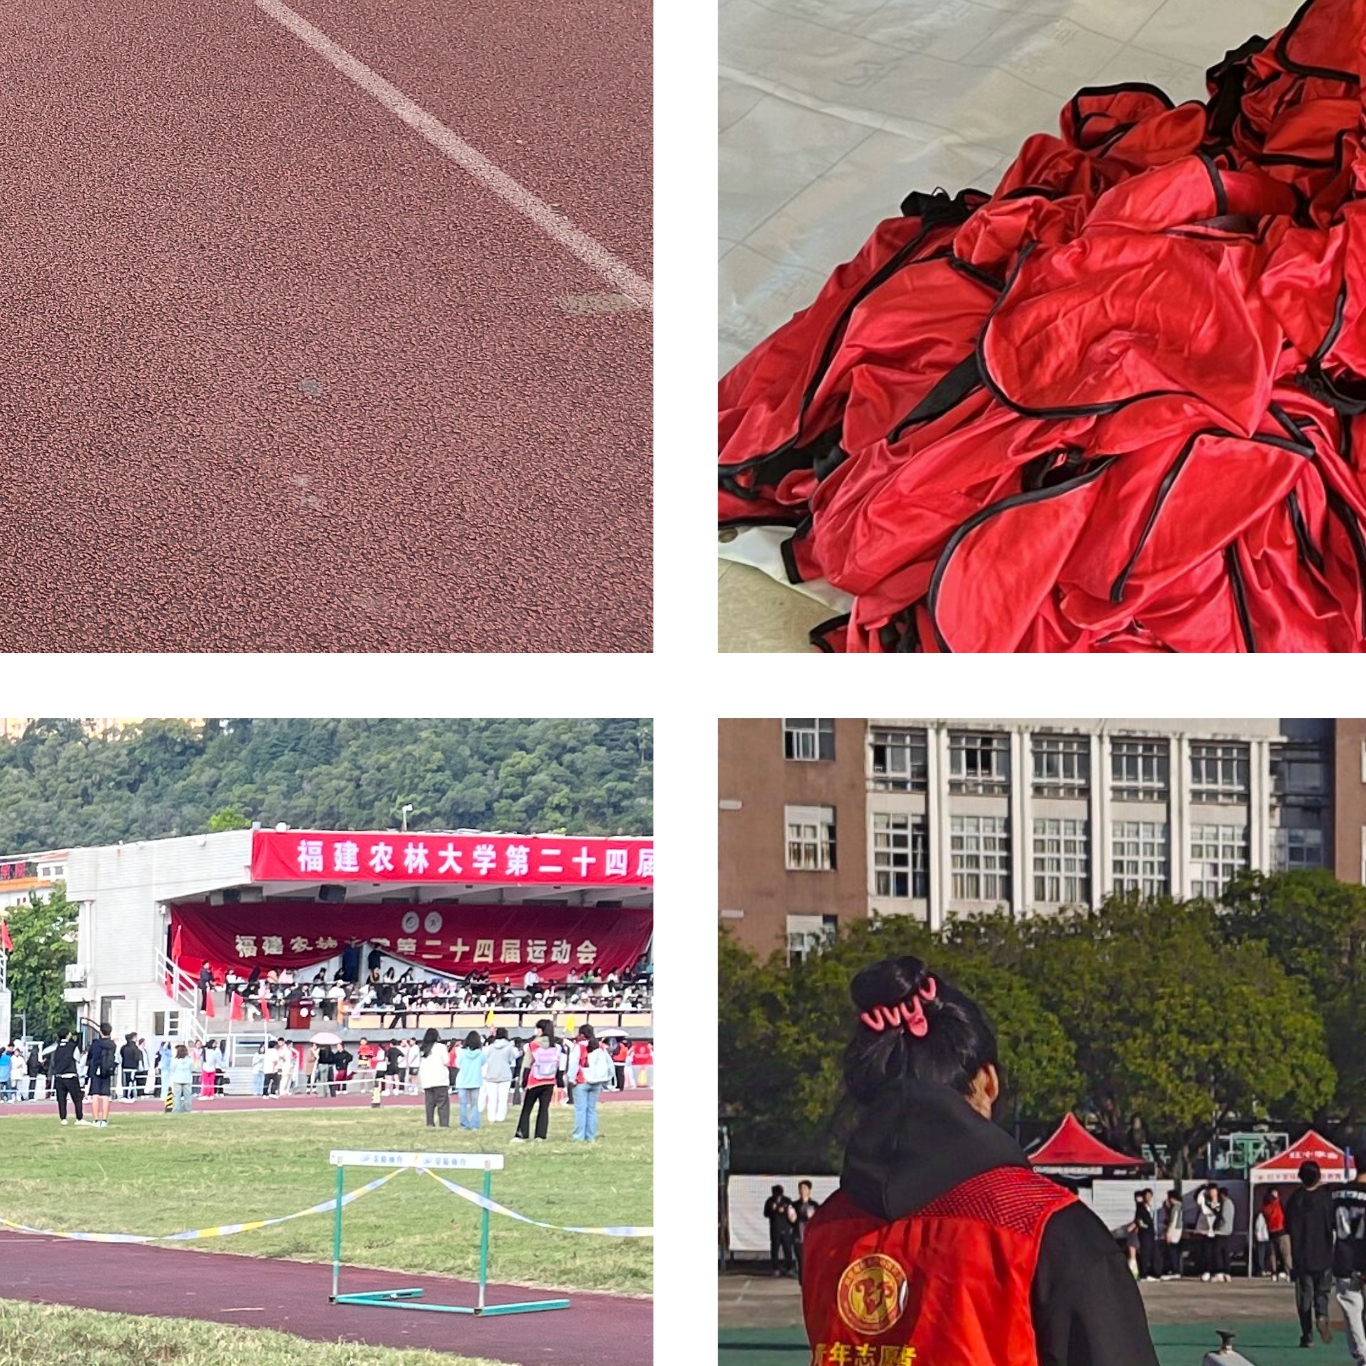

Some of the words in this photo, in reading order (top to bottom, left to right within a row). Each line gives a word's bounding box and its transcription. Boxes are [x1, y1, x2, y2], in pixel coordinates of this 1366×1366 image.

[297, 839, 654, 878] 福建农林大学第二十四届
[235, 935, 598, 965] 福建农林第二十四届运动会
